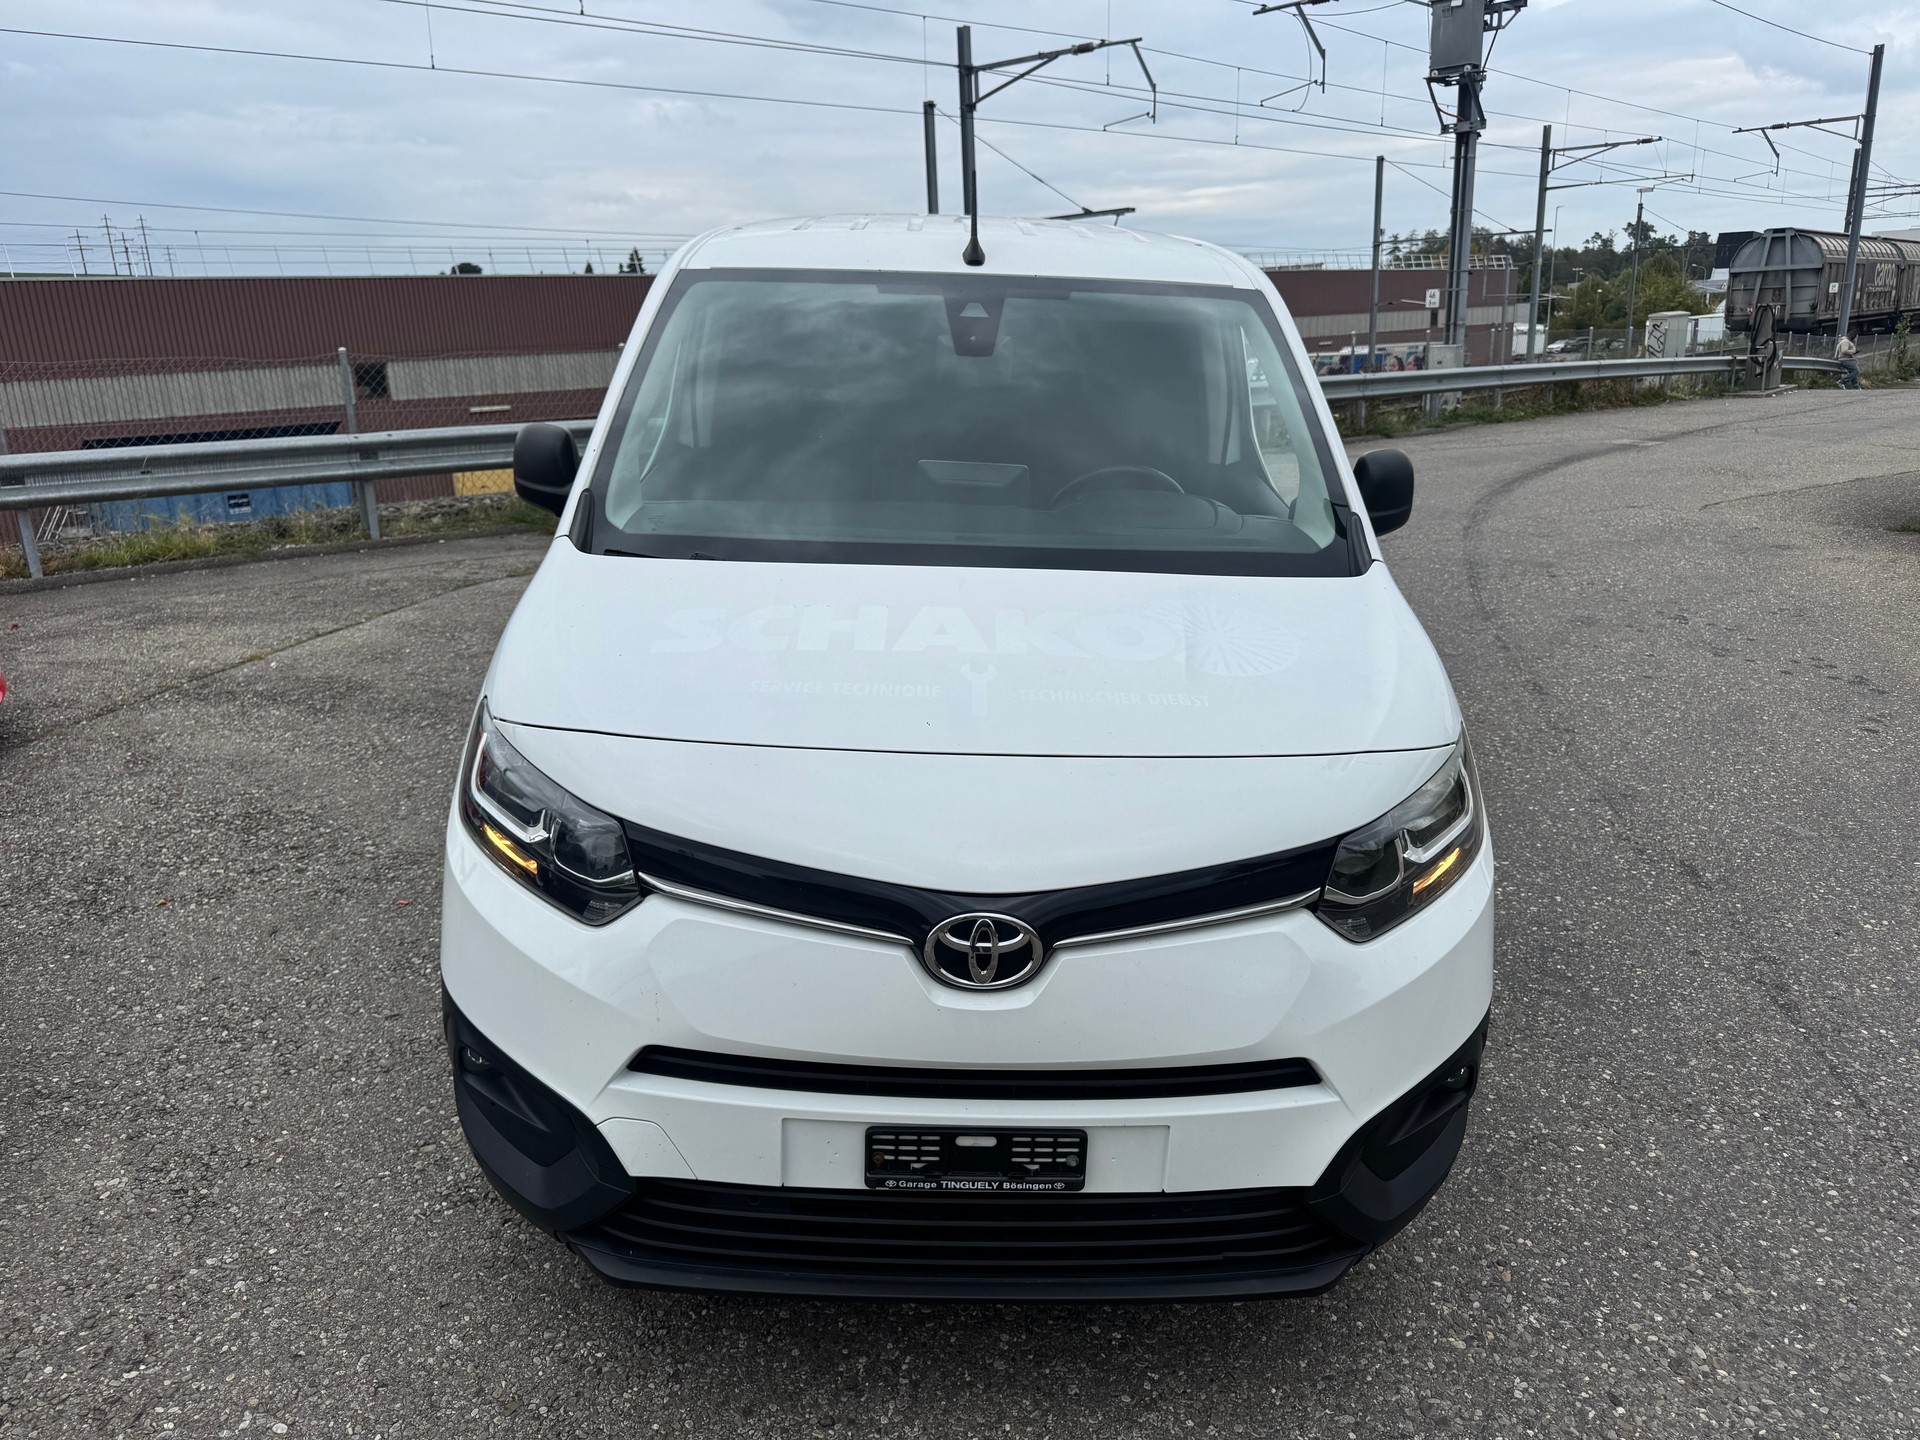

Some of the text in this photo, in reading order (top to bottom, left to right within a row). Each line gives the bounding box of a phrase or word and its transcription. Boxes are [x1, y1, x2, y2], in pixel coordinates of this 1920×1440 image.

[650, 604, 1176, 661] SCHAKO
[750, 680, 942, 698] SERVICE TECHNIQUE
[1017, 689, 1210, 708] TECHNISCHER DIENST
[898, 1180, 1052, 1191] Garage TINGUELY Bösingen
